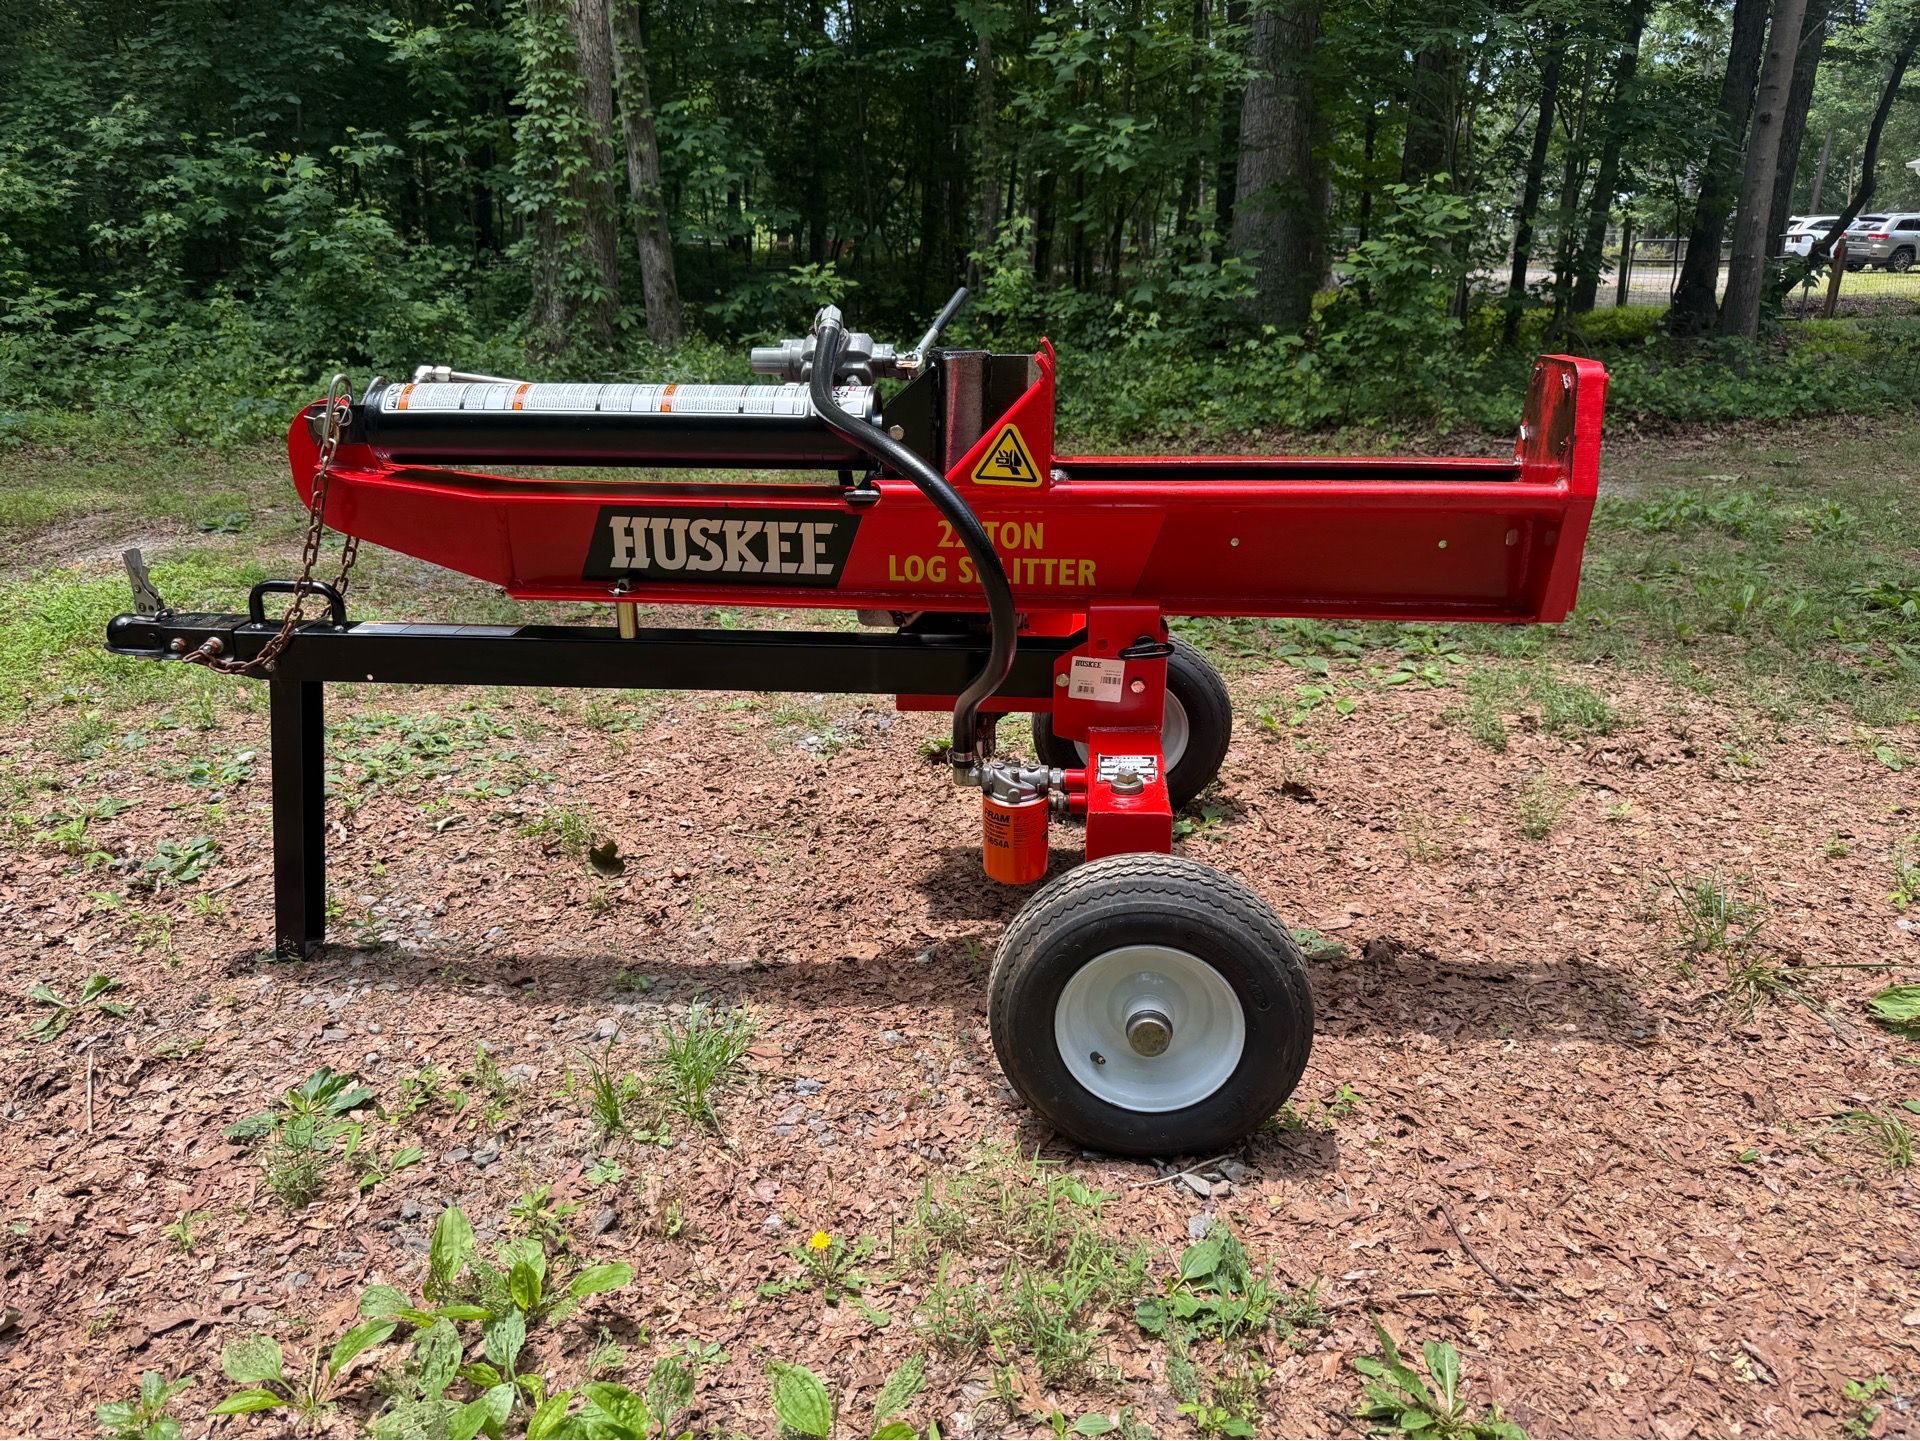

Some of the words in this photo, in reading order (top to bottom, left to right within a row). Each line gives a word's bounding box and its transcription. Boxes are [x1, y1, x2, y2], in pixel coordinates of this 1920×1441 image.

[609, 515, 835, 575] HUSKEE
[937, 520, 967, 548] 2
[981, 521, 1044, 550] TON
[889, 554, 947, 583] LOG
[958, 556, 1097, 586] SITTER
[1075, 659, 1102, 669] HUSKEE
[985, 807, 1011, 823] FRAM
